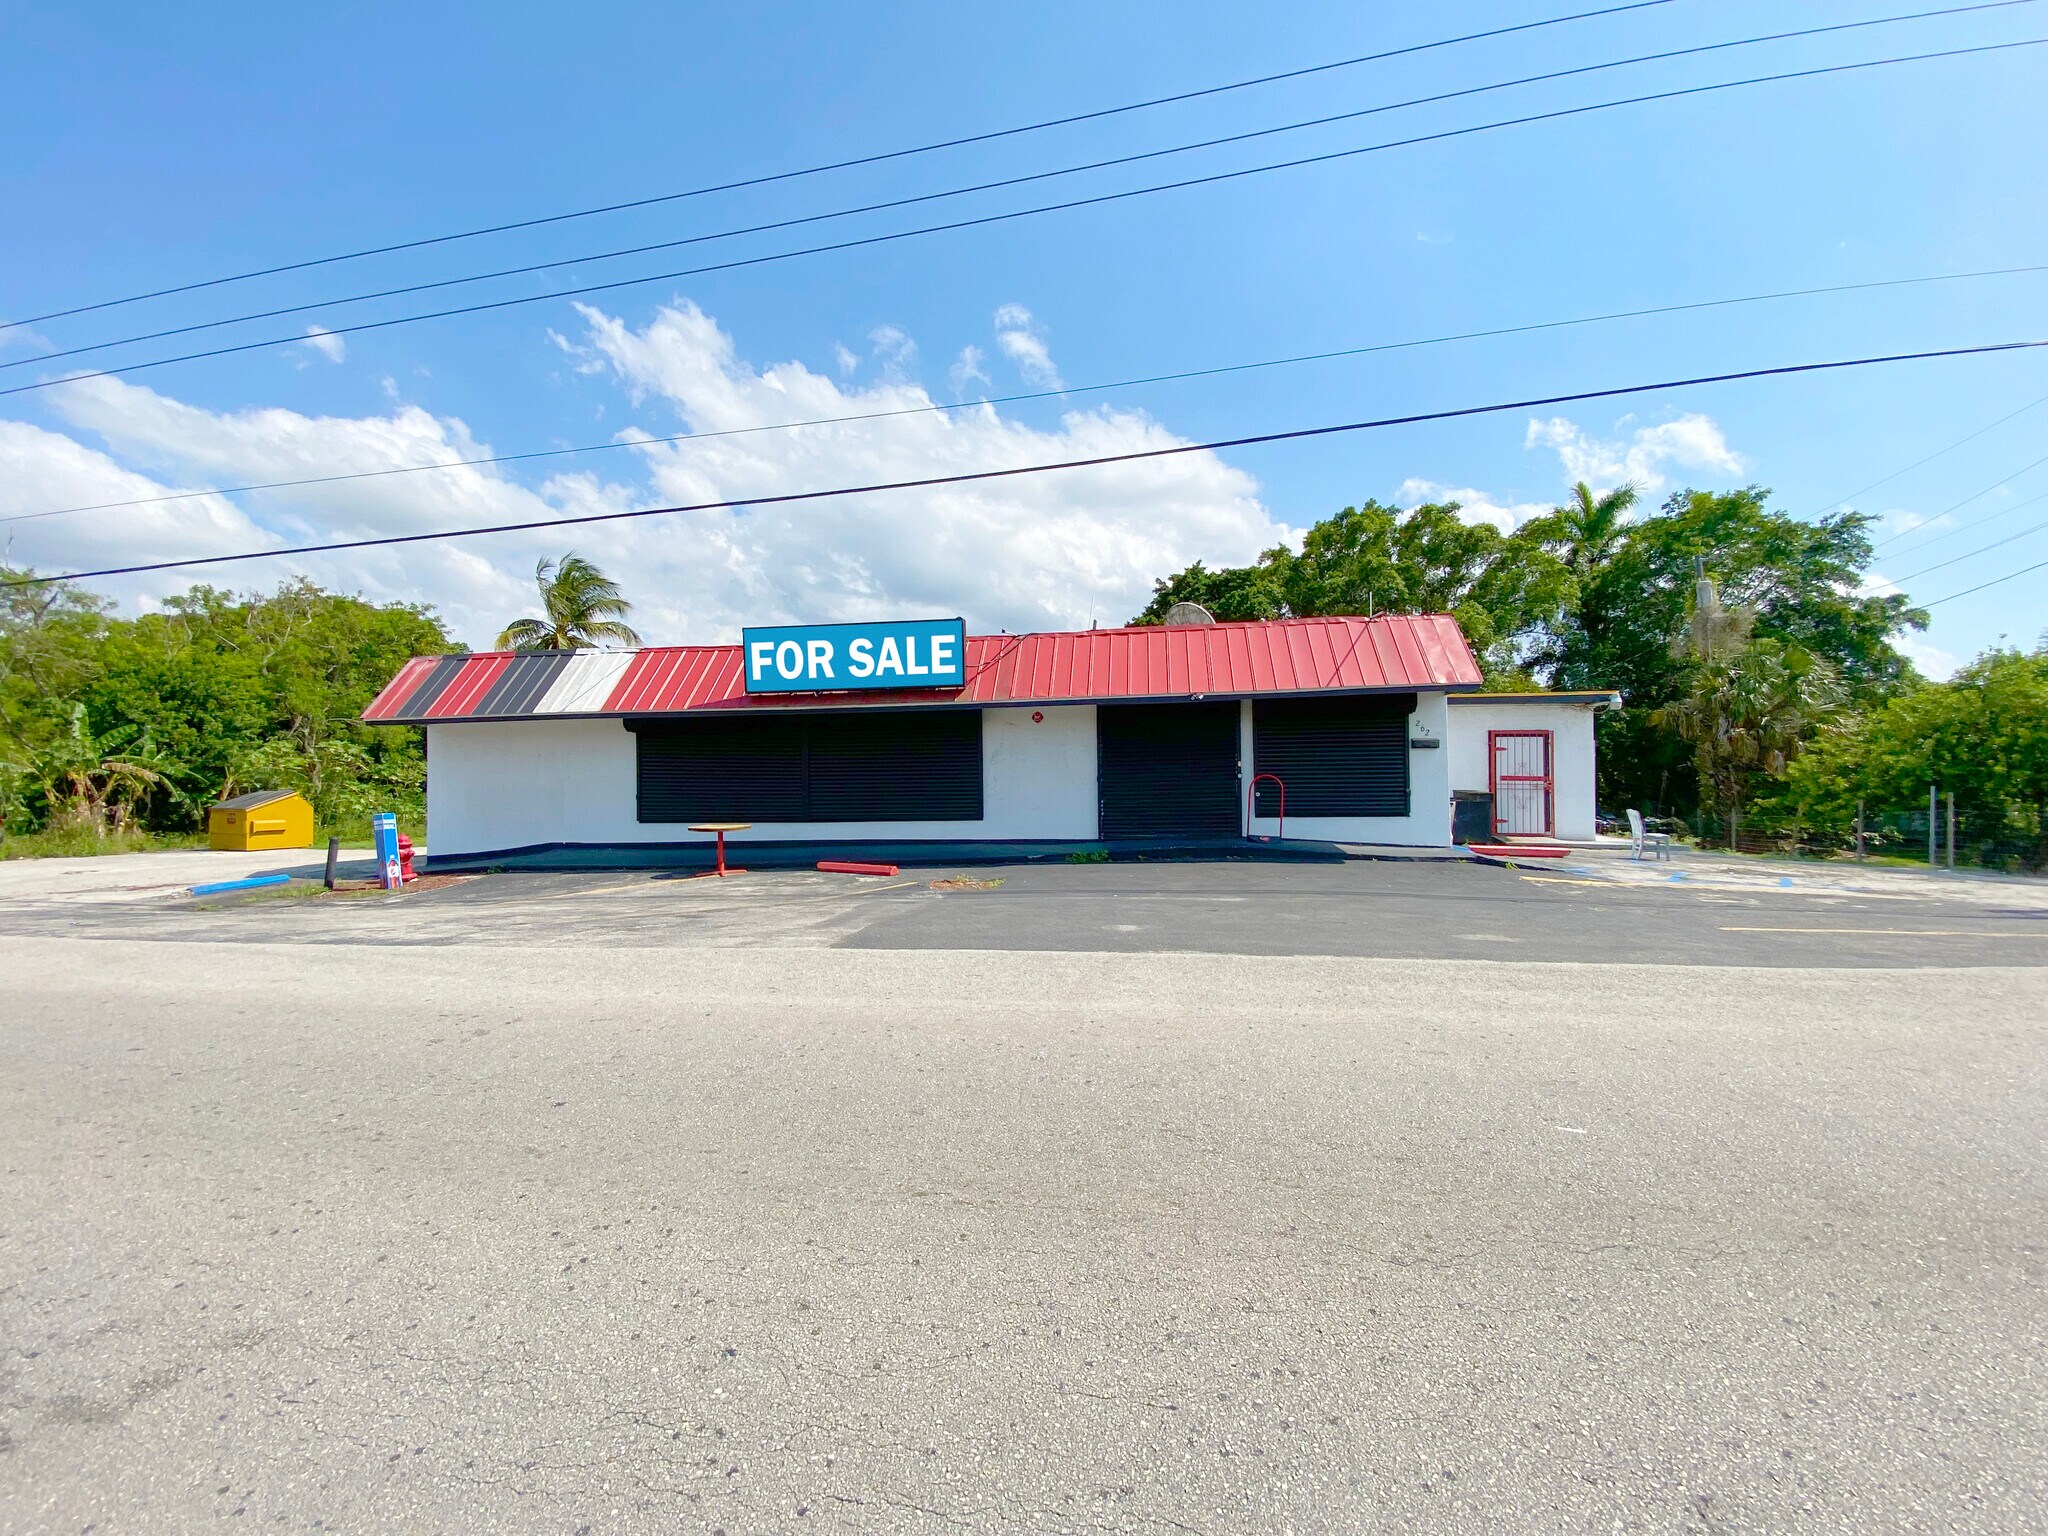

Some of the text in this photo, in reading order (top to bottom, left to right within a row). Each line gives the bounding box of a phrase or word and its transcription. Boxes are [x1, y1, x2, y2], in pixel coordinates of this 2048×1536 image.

[750, 635, 956, 681] FOR SALE
[1415, 720, 1430, 736] 262
